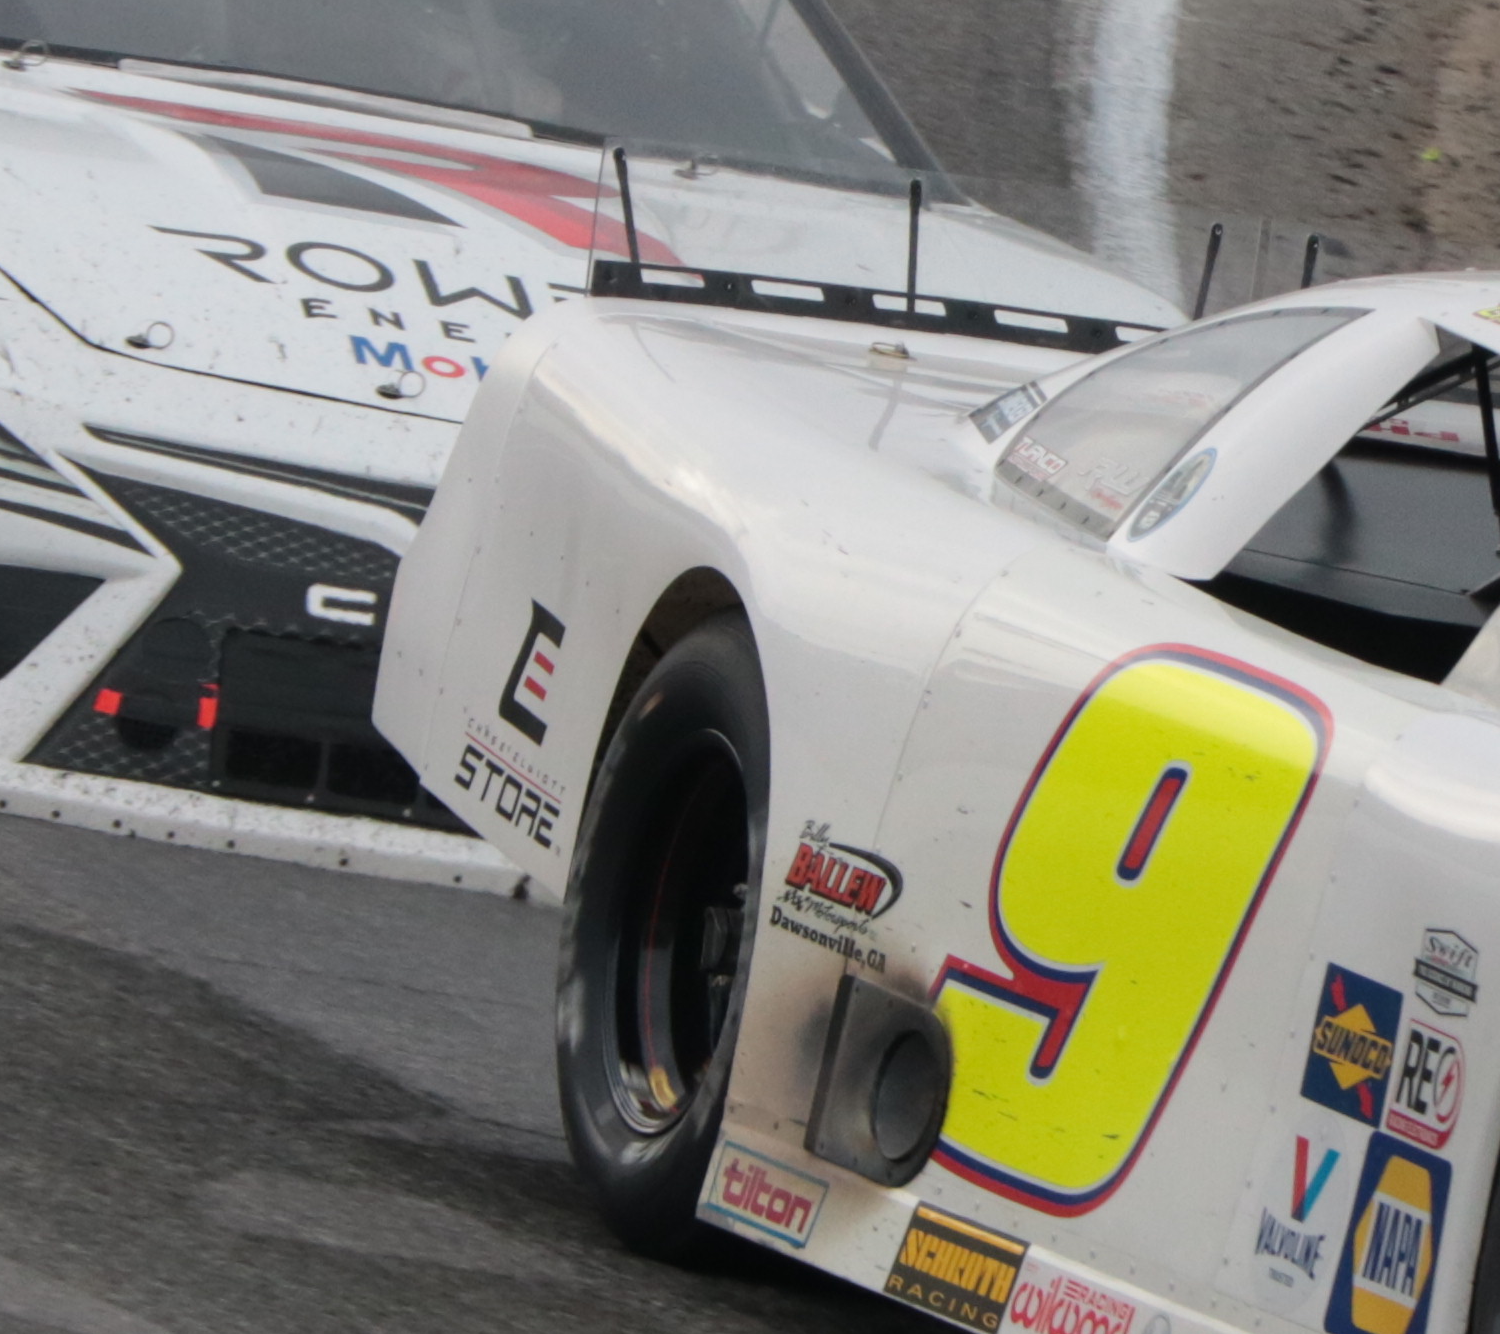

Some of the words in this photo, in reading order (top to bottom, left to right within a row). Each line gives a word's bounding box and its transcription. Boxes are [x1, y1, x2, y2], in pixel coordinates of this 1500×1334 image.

[146, 224, 588, 321] ROW
[299, 297, 513, 344] ENE
[453, 743, 561, 850] STORE
[785, 842, 888, 915] BALLEW
[929, 641, 1334, 1219] 9
[1425, 935, 1474, 969] Swift
[1315, 1018, 1393, 1079] SUNOCO
[722, 1157, 814, 1234] tilton
[899, 1227, 1018, 1304] SCHROTH
[1255, 1206, 1327, 1281] VALVOLINE
[1362, 1200, 1425, 1301] NAPA
[886, 1273, 1000, 1329] RACING
[1077, 1282, 1131, 1321] RACING
